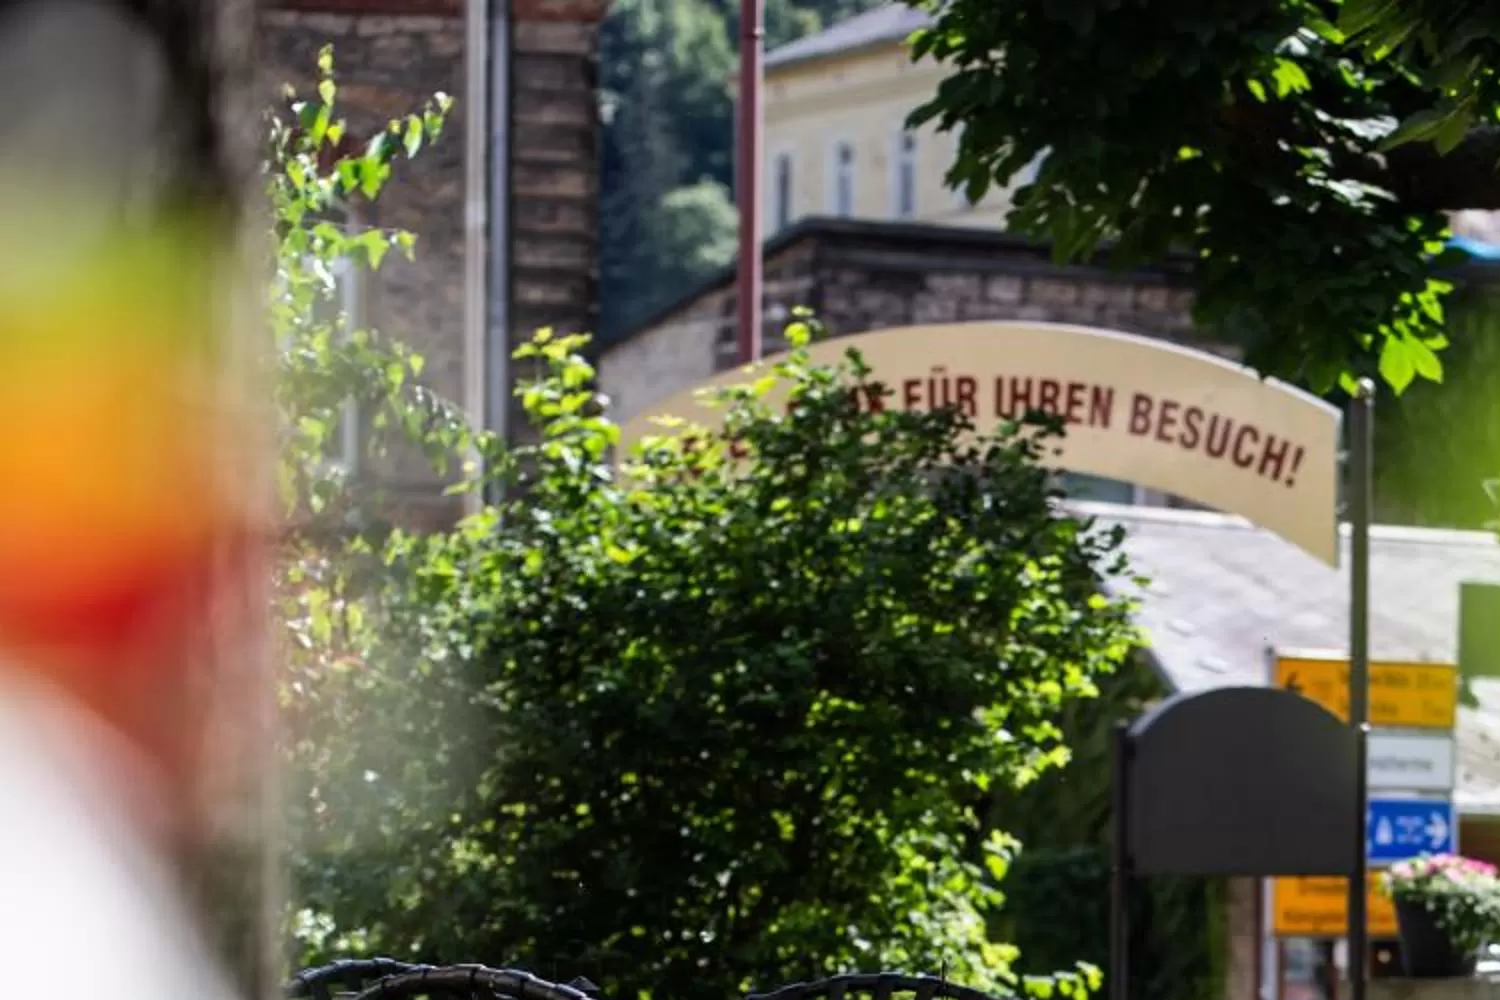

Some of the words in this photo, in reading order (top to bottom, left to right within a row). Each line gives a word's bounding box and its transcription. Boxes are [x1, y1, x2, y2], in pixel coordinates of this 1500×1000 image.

[903, 364, 977, 418] FÜR
[994, 374, 1114, 429] IHREN
[1129, 392, 1305, 488] BESUCH!
